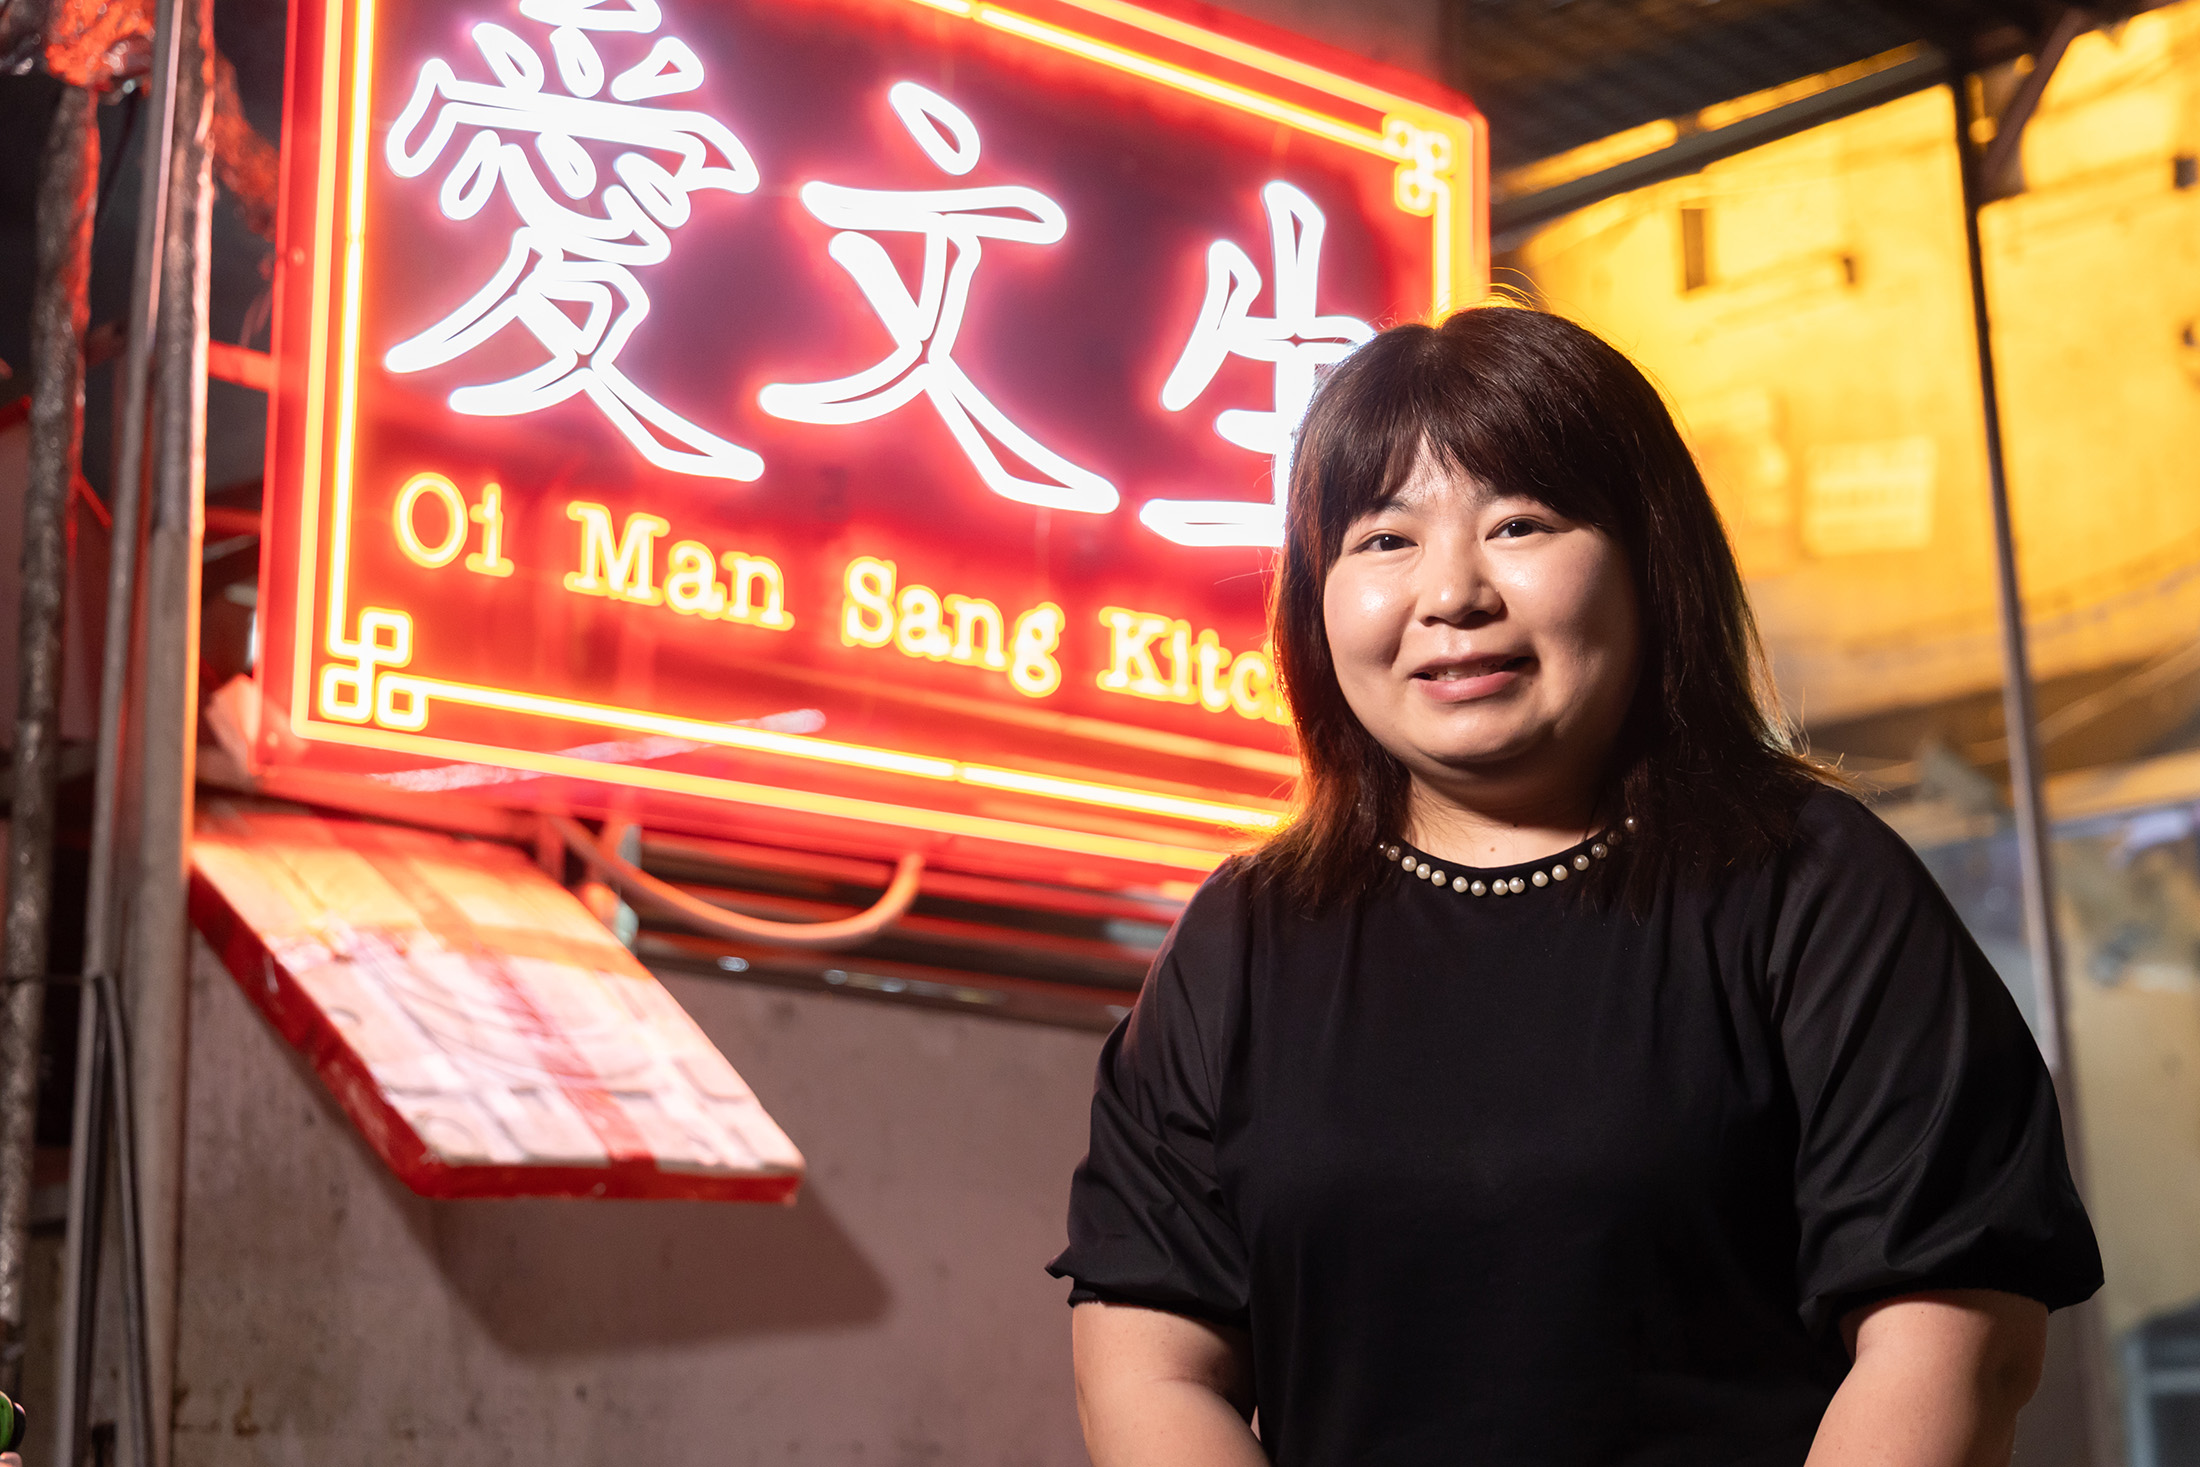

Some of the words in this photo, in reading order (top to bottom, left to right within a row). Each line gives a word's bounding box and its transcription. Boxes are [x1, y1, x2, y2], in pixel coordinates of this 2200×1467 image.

[384, 0, 1377, 547] 愛文生
[393, 472, 514, 578] Oi
[563, 501, 796, 631] Man
[841, 556, 1065, 698] Sang
[1096, 606, 1291, 726] Kitc
